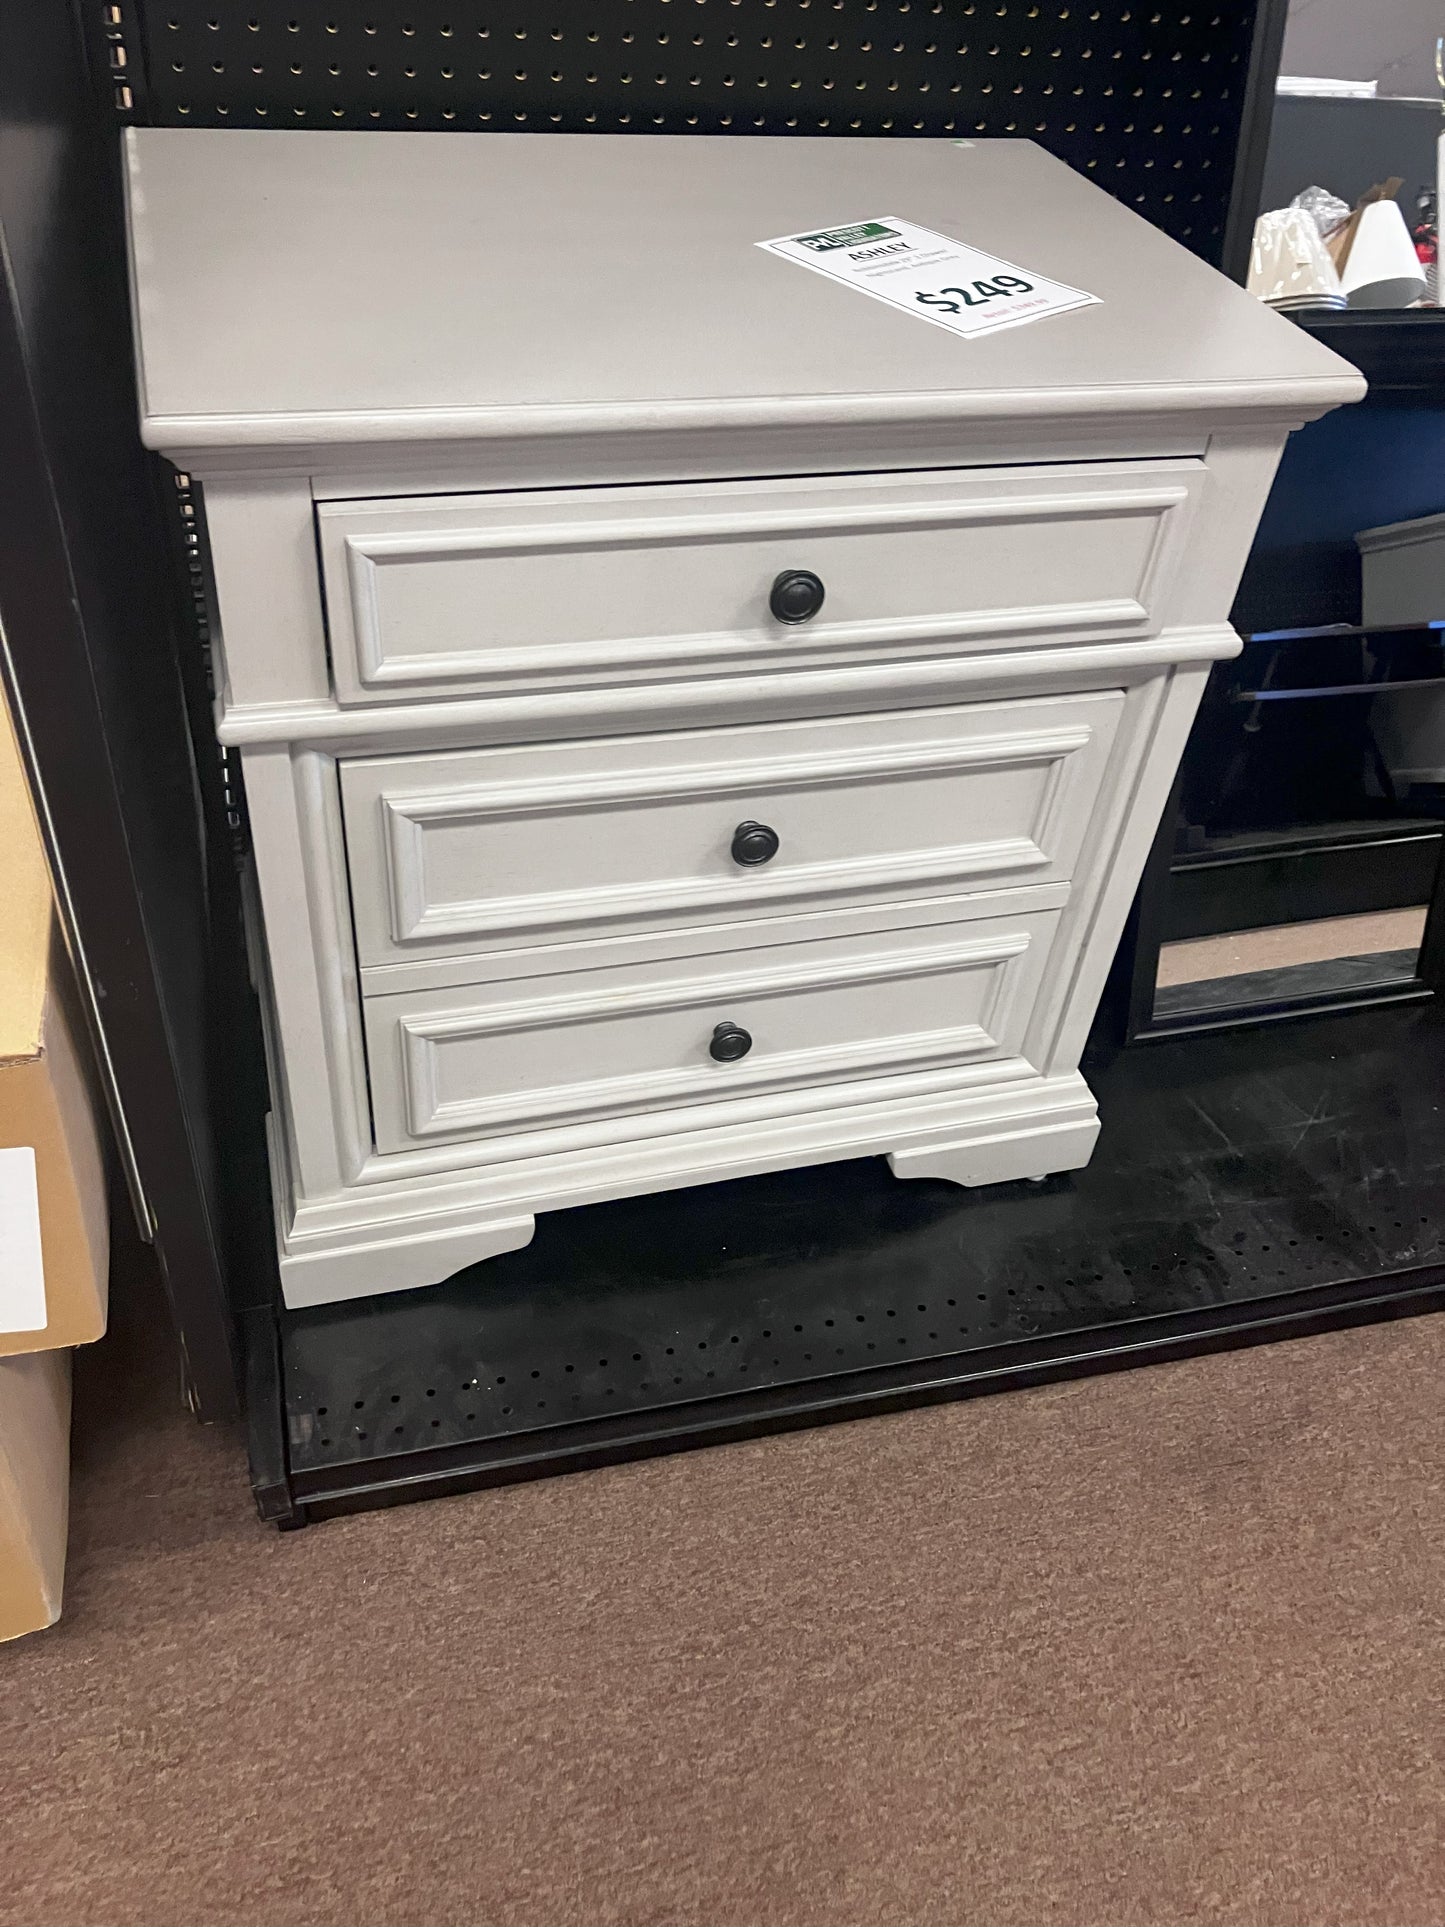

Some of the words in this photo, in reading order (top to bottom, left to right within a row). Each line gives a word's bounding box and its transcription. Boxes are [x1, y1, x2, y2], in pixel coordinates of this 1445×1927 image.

[801, 236, 842, 250] PVL
[848, 242, 911, 261] ASHLEY
[914, 275, 1034, 315] $249
